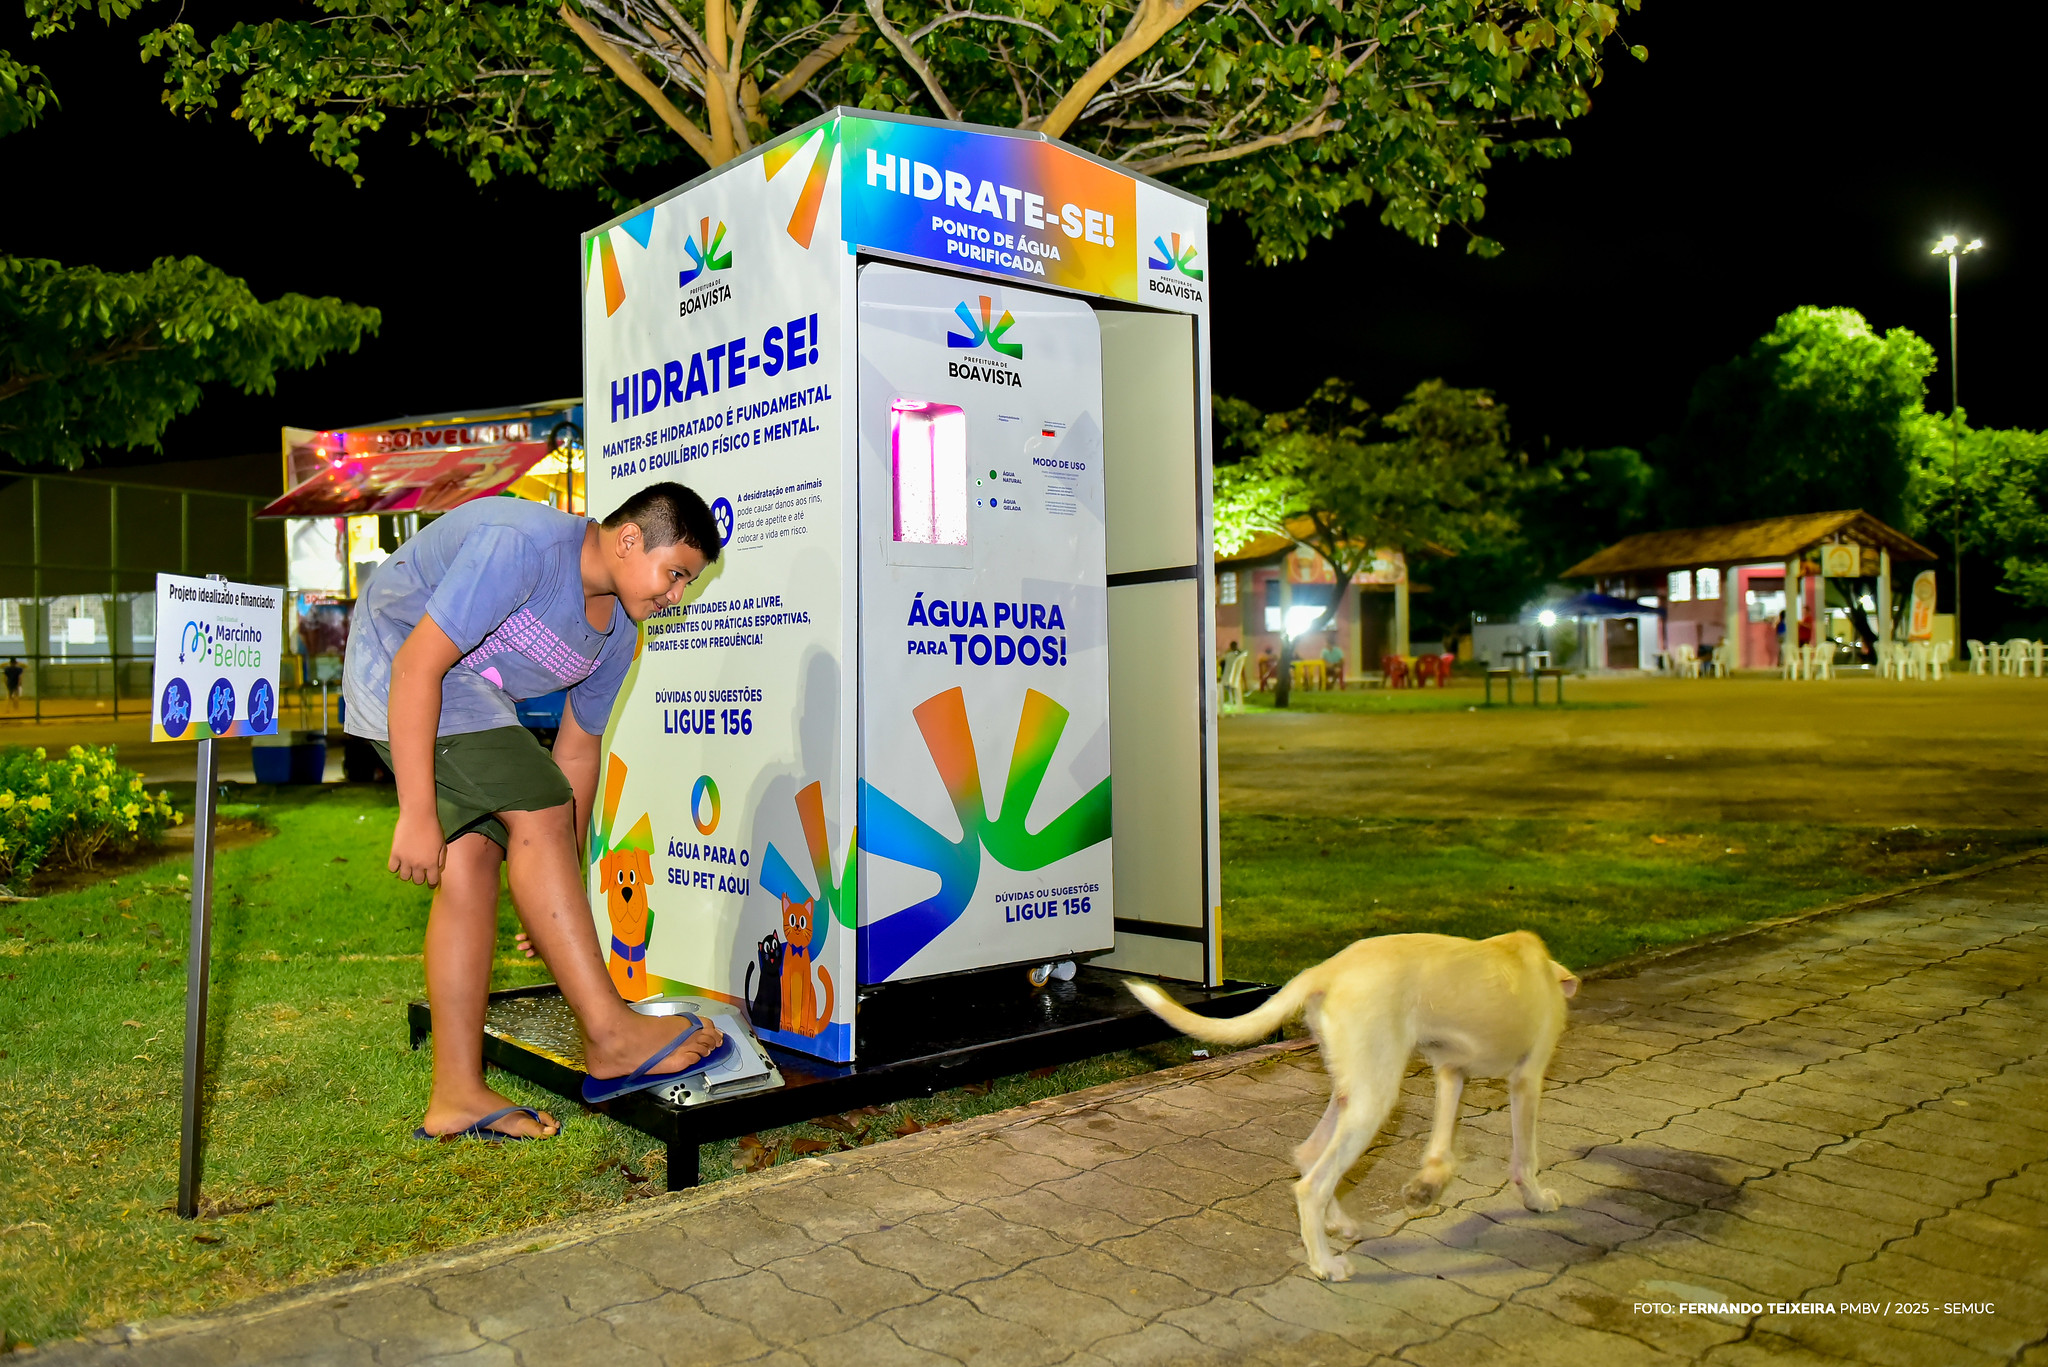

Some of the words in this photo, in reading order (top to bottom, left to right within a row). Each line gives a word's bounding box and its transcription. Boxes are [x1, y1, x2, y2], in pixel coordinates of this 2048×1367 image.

[866, 147, 1115, 248] HIDRATE-SE!
[932, 216, 990, 244] PONTO
[993, 231, 1014, 250] DE
[1017, 234, 1061, 261] ÁGUA
[947, 239, 1045, 276] PURIFICADA
[690, 281, 714, 295] PREFEITURA
[611, 313, 819, 424] HIDRATE-SE!
[964, 356, 1000, 367] PREFEITURA
[603, 431, 658, 459] MANTER-SE
[660, 413, 723, 444] HIDRATADO
[726, 406, 734, 426] É
[736, 384, 832, 424] FUNDAMENTAL
[611, 461, 637, 480] PARA
[639, 458, 647, 473] O
[649, 441, 709, 471] EQUILÍBRIO
[712, 431, 750, 455] FÍSICO
[753, 429, 761, 446] E
[764, 416, 820, 443] MENTAL.
[1032, 457, 1058, 468] MODO
[1059, 460, 1069, 469] DE
[1070, 461, 1086, 471] USO
[737, 494, 743, 503] A
[743, 486, 784, 502] desidratação
[785, 485, 795, 495] em
[796, 478, 823, 492] animais
[1002, 477, 1022, 485] NATURAL
[737, 505, 753, 518] pode
[753, 502, 773, 514] causar
[774, 497, 795, 510] danos
[796, 497, 808, 506] aos
[808, 494, 823, 505] rins,
[737, 518, 755, 532] perda
[756, 516, 764, 527] de
[765, 513, 787, 527] apetite
[788, 514, 793, 522] e
[793, 510, 805, 521] até
[737, 530, 759, 544] colocar
[759, 532, 764, 541] a
[765, 526, 778, 539] vida
[779, 528, 790, 538] em
[791, 525, 808, 536] risco.
[169, 583, 197, 602] Projeto
[198, 588, 233, 605] idealizado
[235, 593, 240, 606] e
[240, 592, 275, 609] financiado:
[682, 600, 727, 616] ATIVIDADES
[729, 599, 741, 611] AO
[743, 598, 754, 609] AR
[756, 595, 783, 609] LIVRE,
[648, 623, 664, 636] DIAS
[665, 620, 700, 634] QUENTES
[701, 619, 713, 631] OU
[714, 615, 753, 630] PRÁTICAS
[755, 611, 811, 627] ESPORTIVAS,
[907, 592, 989, 628] ÁGUA
[994, 602, 1066, 630] PURA
[215, 622, 262, 643] Marcinho
[648, 638, 689, 652] HIDRATE-SE
[691, 637, 708, 649] COM
[709, 632, 763, 648] FREQUÊNCIA!
[214, 643, 261, 668] Belota
[907, 640, 948, 655] PARA
[949, 634, 1067, 667] TODOS!
[655, 687, 692, 703] DÚVIDAS
[694, 690, 706, 703] OU
[708, 686, 762, 702] SUGESTÕES
[664, 708, 716, 734] LIGUE
[720, 708, 753, 735] 156
[668, 836, 700, 861] ÁGUA
[703, 844, 736, 865] PARA
[740, 849, 750, 867] O
[668, 867, 690, 886] SEU
[693, 872, 715, 890] PET
[718, 875, 750, 896] AQUI
[995, 890, 1034, 903] DÚVIDAS
[1036, 889, 1049, 898] OU
[1051, 883, 1099, 896] SUGESTÕES
[1005, 900, 1058, 923] LIGUE
[1062, 897, 1091, 915] 156
